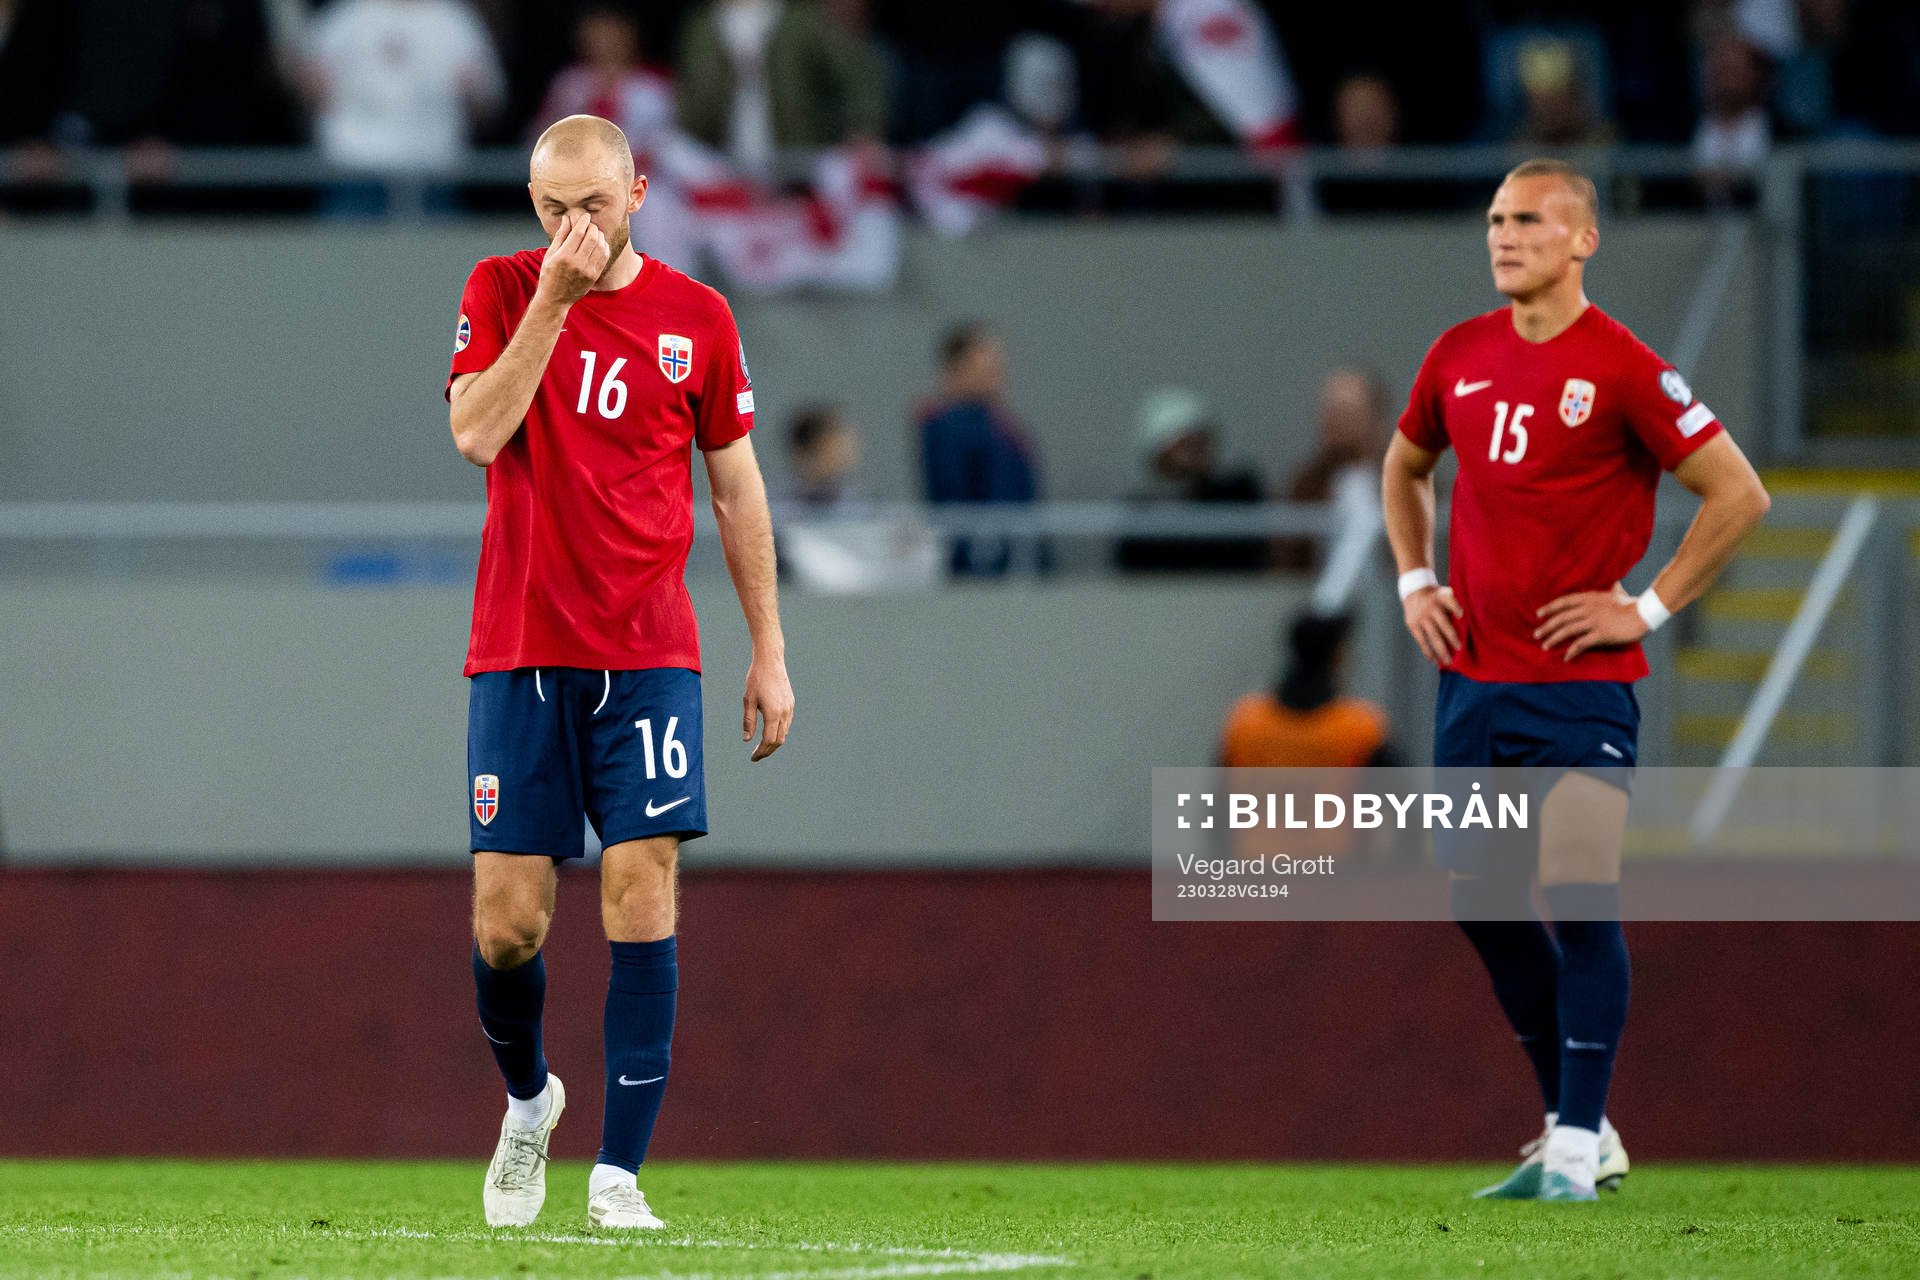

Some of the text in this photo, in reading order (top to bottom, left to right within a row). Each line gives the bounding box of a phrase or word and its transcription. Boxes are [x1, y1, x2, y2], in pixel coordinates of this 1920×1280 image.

[577, 350, 628, 420] 16
[1489, 402, 1534, 464] 15
[635, 716, 688, 780] 16
